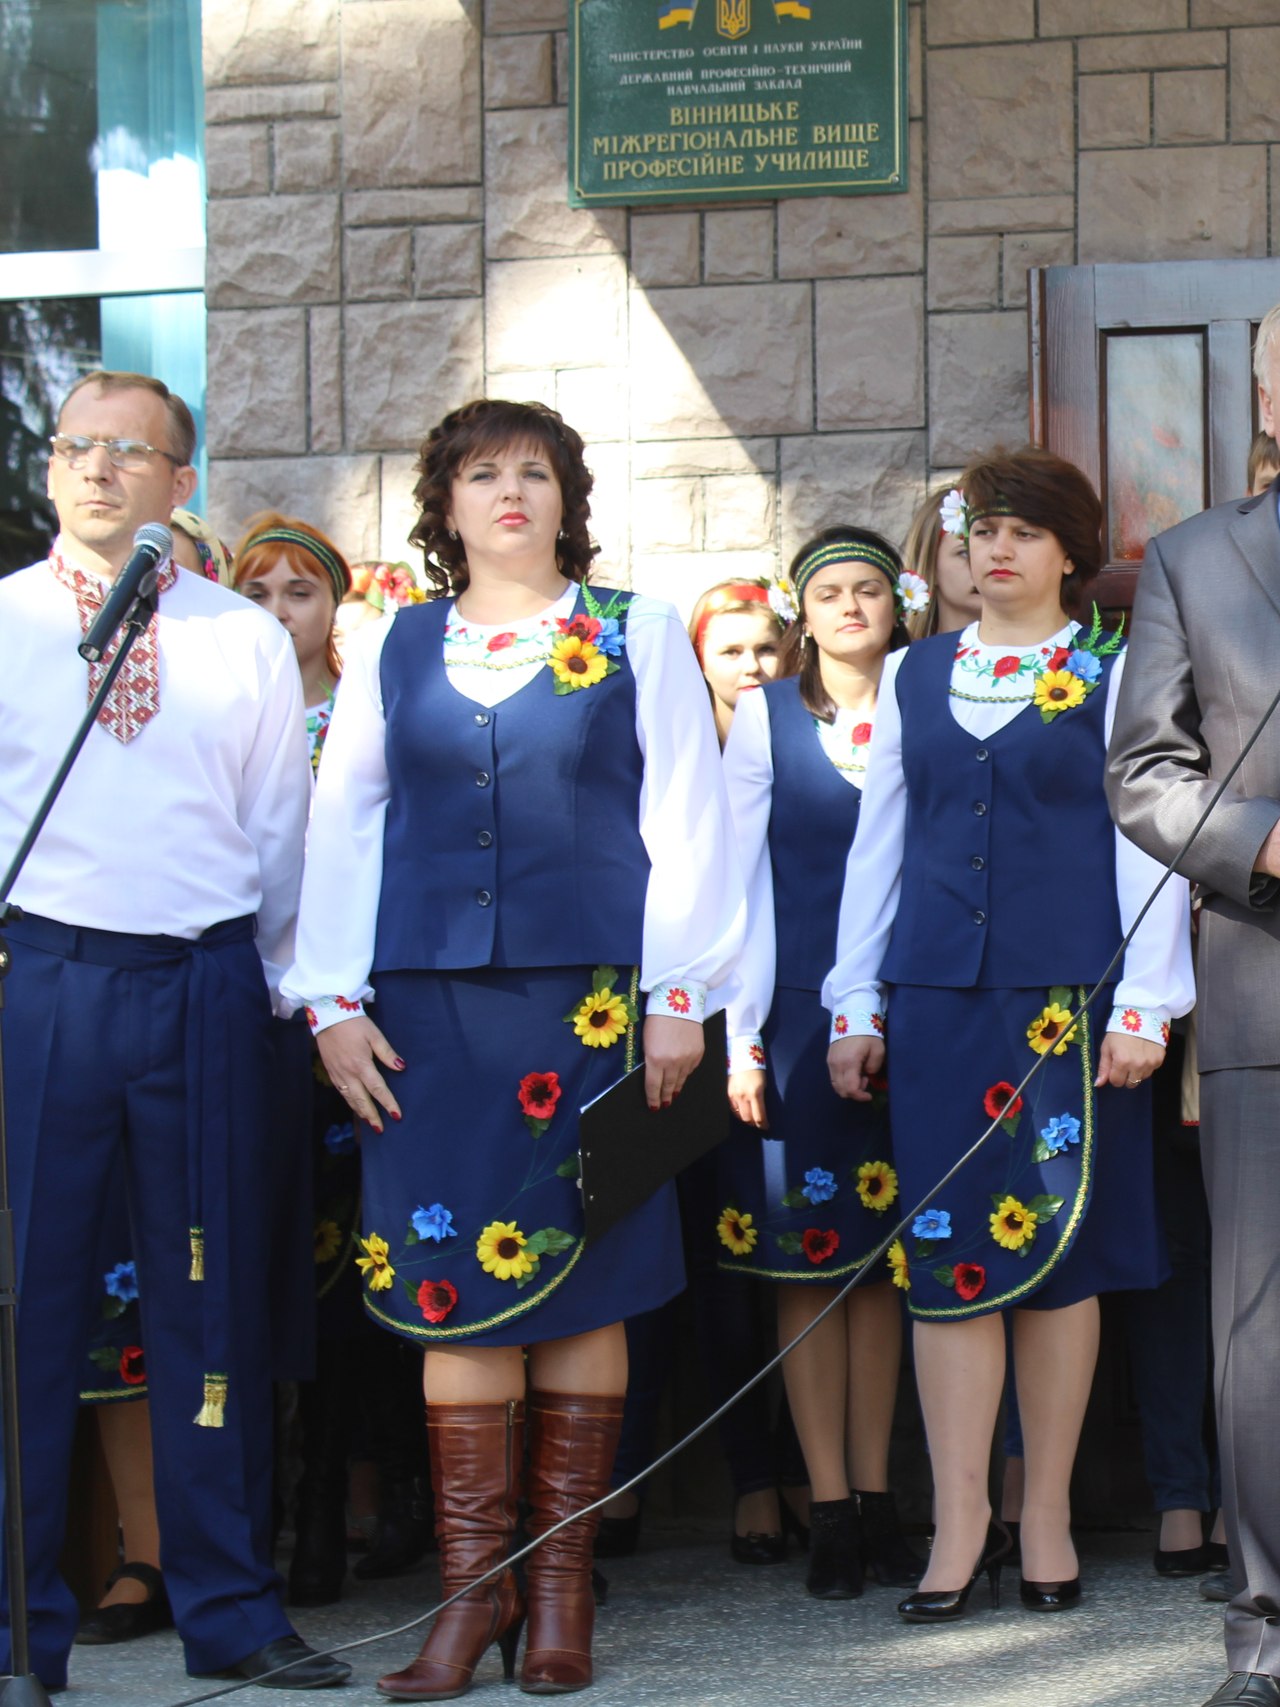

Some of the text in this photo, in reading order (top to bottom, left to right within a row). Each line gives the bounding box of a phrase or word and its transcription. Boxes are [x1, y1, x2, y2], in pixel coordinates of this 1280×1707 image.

[609, 37, 863, 63] МІНІСТЕРСТВО ОСВІТИ І НАУКИ УКРАЇНИ
[618, 68, 693, 86] ДЕРЖАВНИЙ
[666, 78, 802, 96] НАВЧАЛЬНИЙ ЗАКЛАД
[670, 101, 799, 126] ВІННИЦЬКЕ
[593, 122, 880, 155] МІЖРЕГІОНАЛЬНЕ ВИЩЕ
[603, 149, 869, 180] ПРОФЕСІЙНЕ УЧИЛИЩЕ
